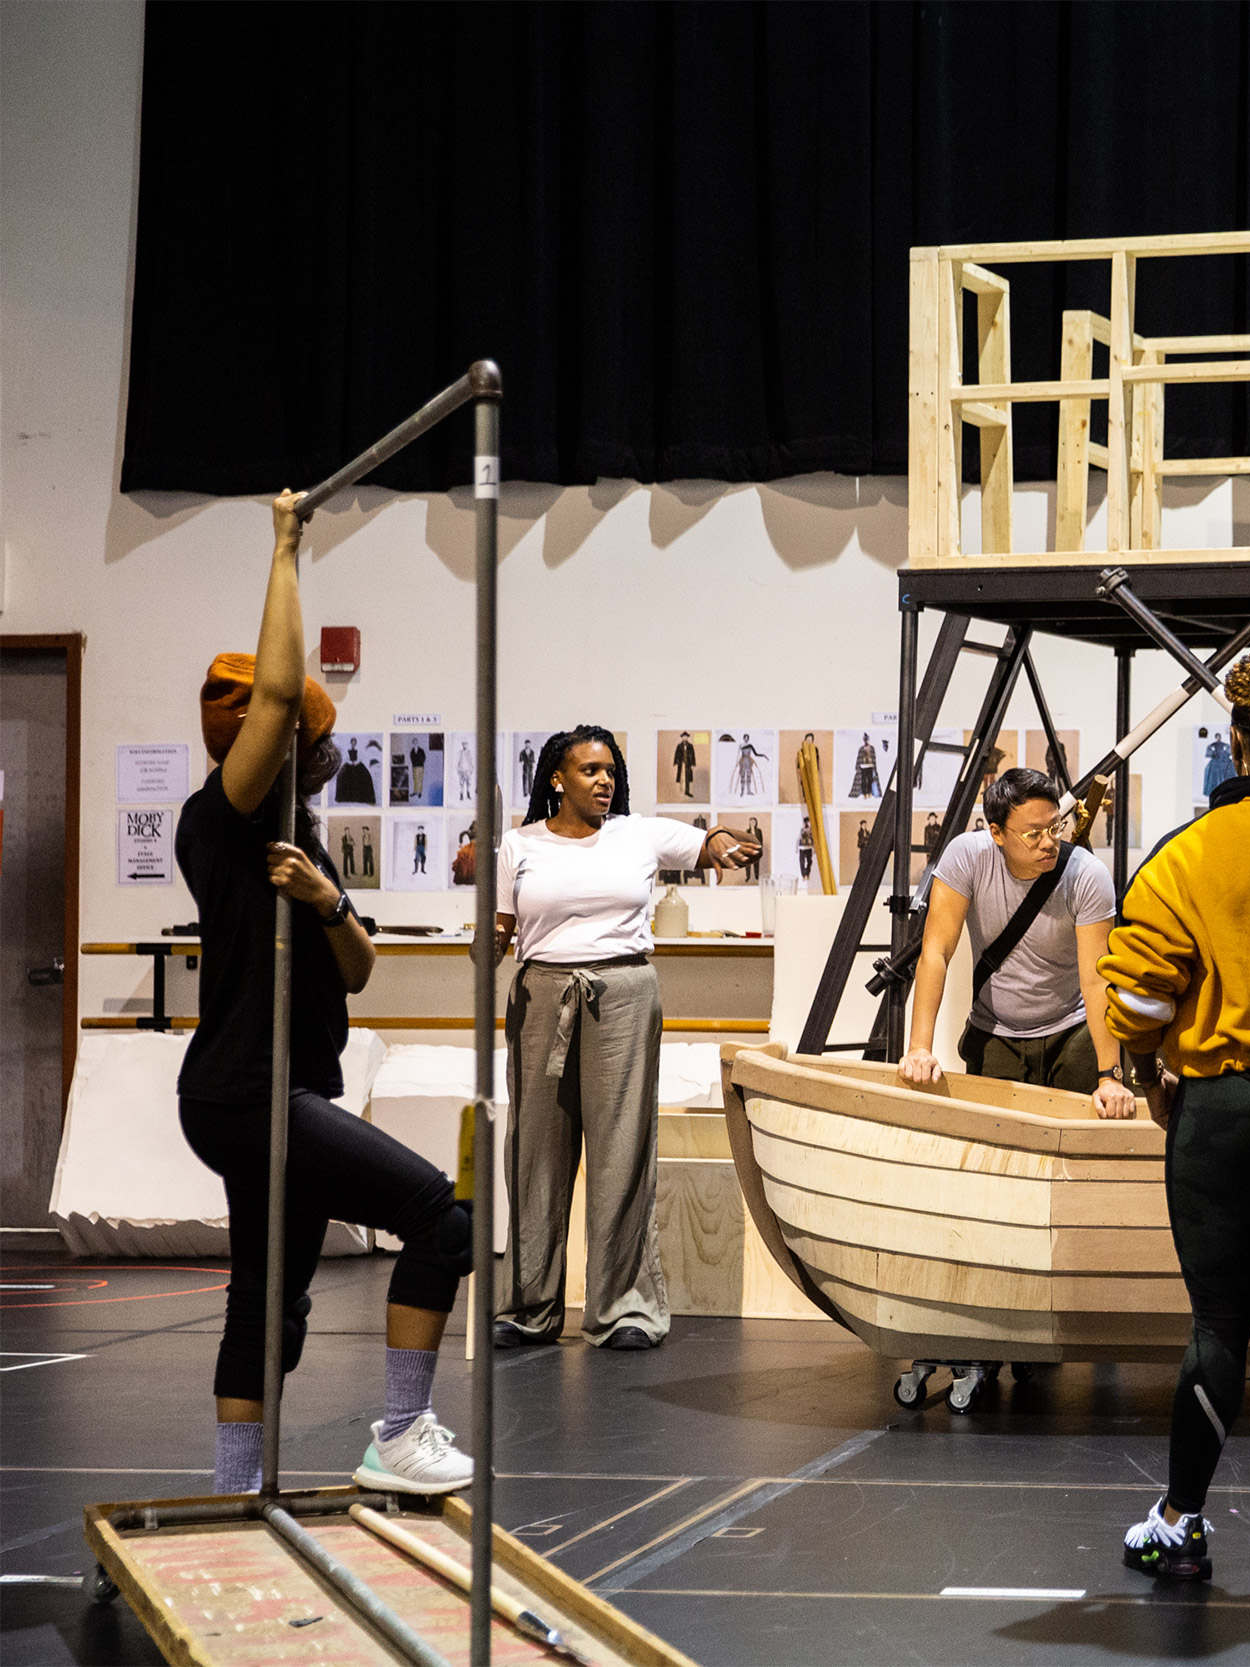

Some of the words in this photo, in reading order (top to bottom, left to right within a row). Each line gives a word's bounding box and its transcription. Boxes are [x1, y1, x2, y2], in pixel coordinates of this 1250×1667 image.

[478, 465, 497, 485] 1
[902, 594, 910, 604] C
[127, 811, 164, 826] MOBY
[127, 823, 161, 838] DICK
